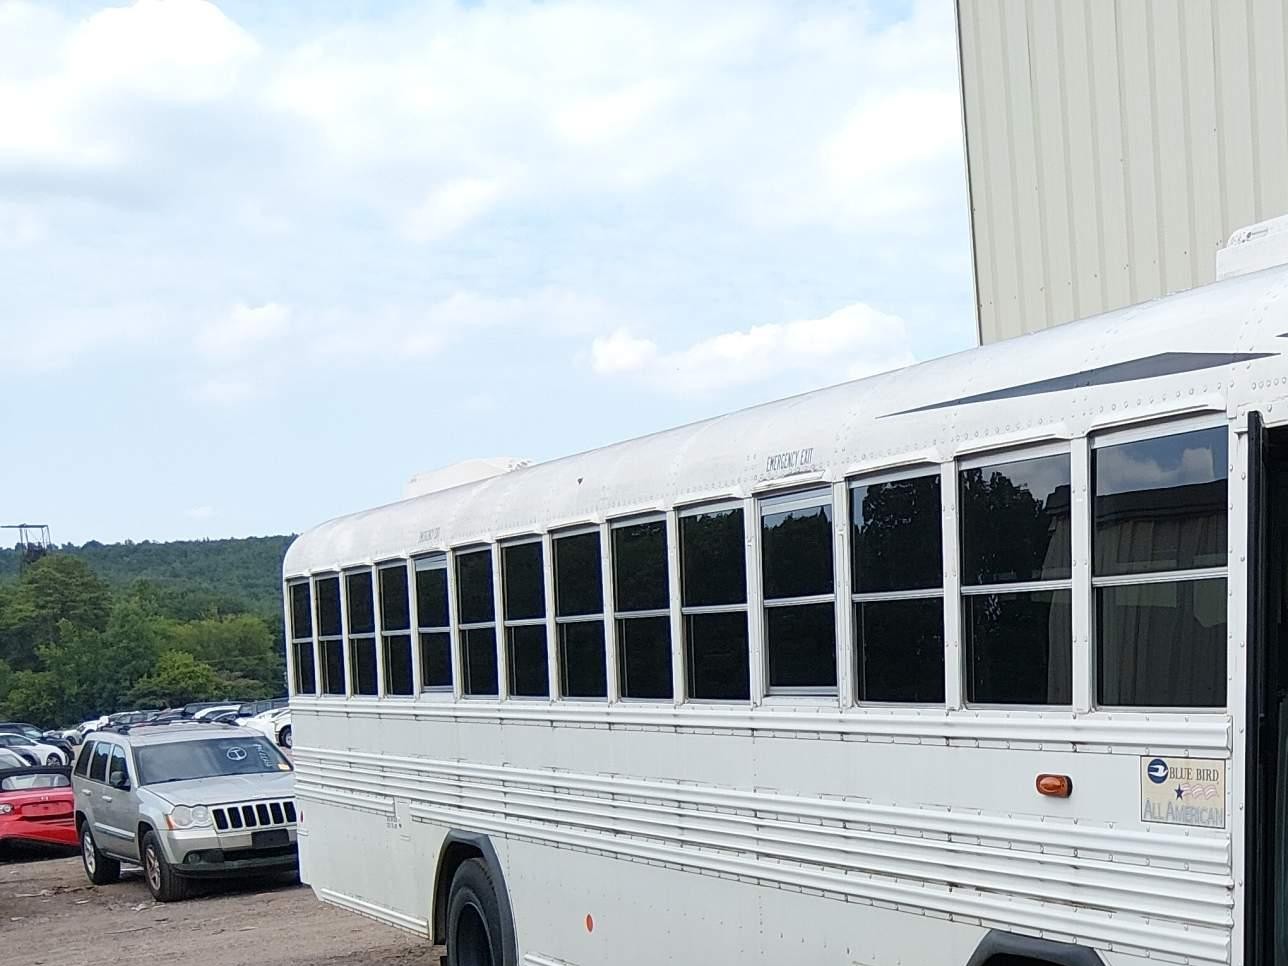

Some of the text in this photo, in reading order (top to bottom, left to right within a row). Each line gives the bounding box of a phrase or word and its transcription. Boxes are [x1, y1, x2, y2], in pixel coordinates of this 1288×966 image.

[766, 447, 814, 472] EMERGENCY EXIT
[1169, 767, 1219, 782] BLUE BIRD
[1143, 799, 1223, 826] ALL AMERICAN
